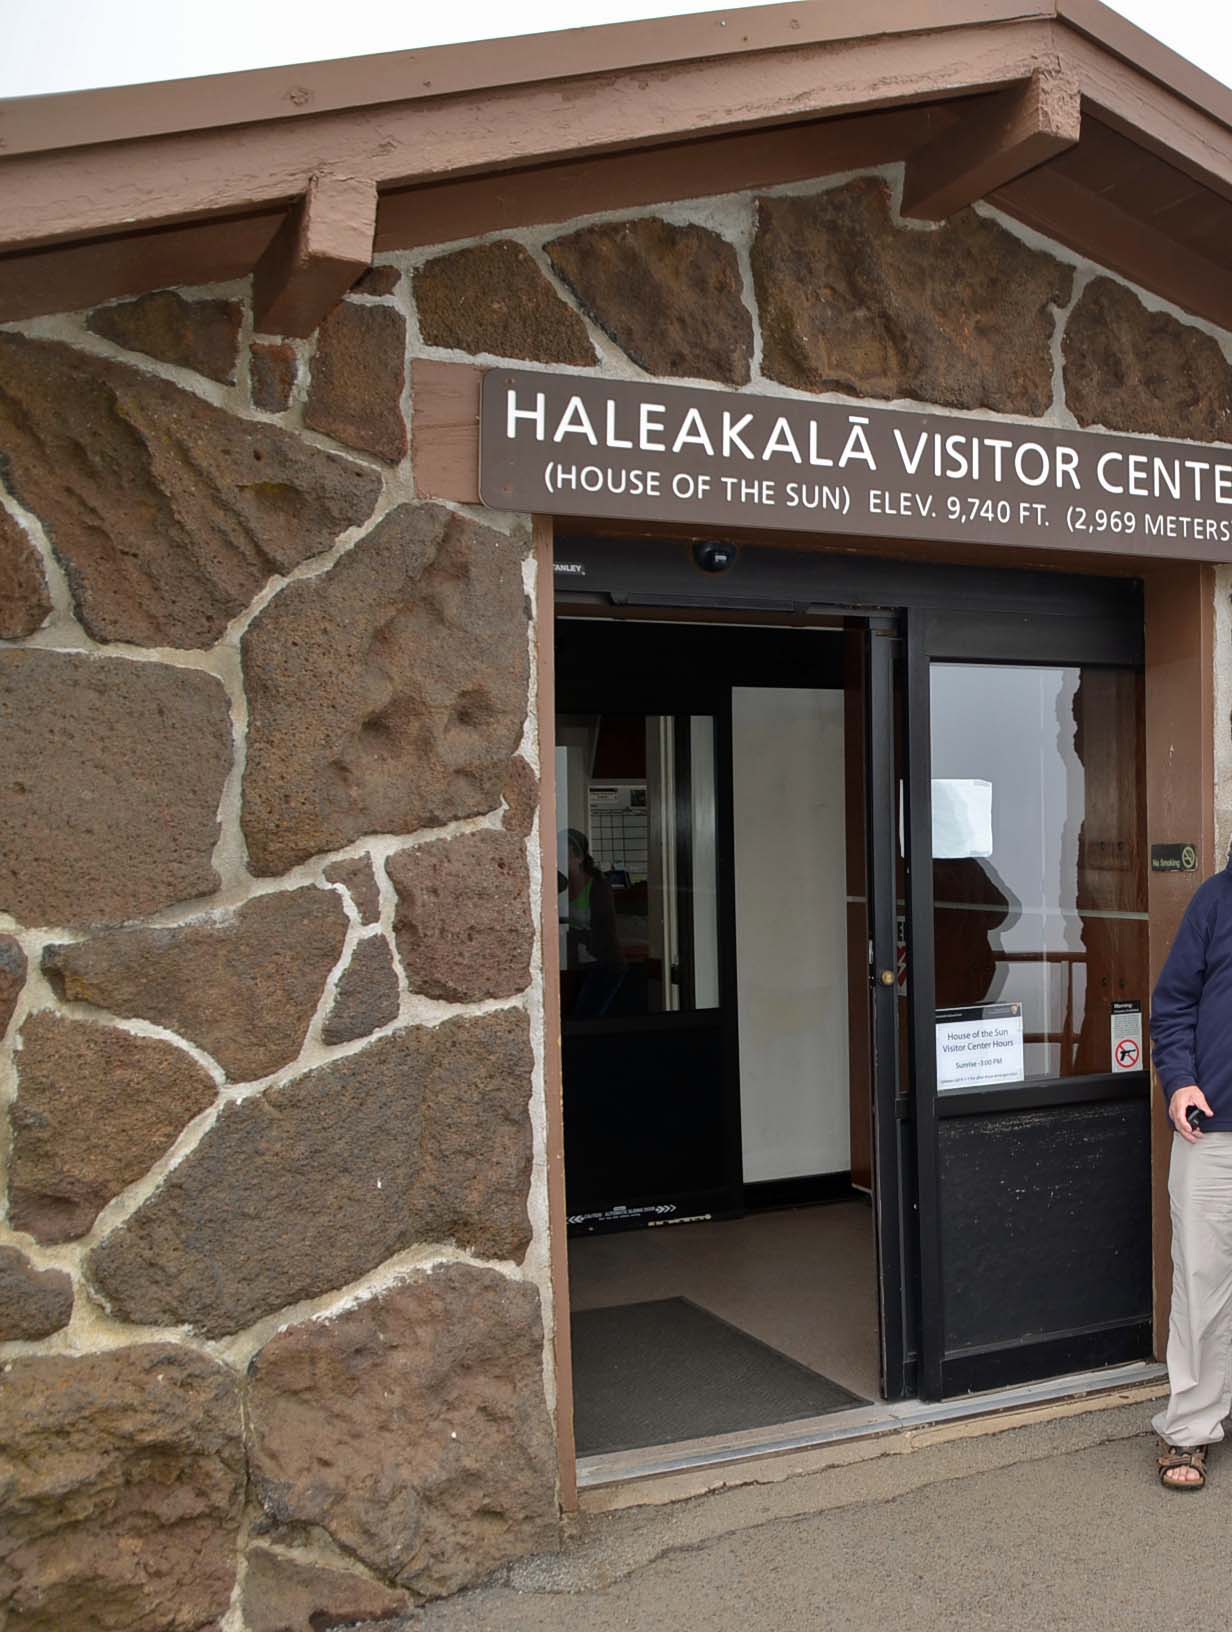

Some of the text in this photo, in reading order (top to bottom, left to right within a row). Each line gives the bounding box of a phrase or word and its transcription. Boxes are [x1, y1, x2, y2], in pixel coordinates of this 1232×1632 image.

[506, 390, 877, 470] HALEAKALĀ
[894, 429, 1080, 490] VISITOR
[544, 461, 661, 496] (HOUSE
[672, 473, 710, 500] OF
[720, 477, 775, 505] THE
[786, 482, 850, 515] SUN)
[869, 490, 937, 518] ELEV.
[947, 496, 1011, 524] 9,740
[1019, 503, 1050, 526] FT.
[1066, 506, 1136, 534] (2,969
[947, 1028, 1009, 1041] House of the Sun
[942, 1039, 1014, 1053] Visitor Center Hours
[955, 1061, 977, 1069] Sunrise
[992, 1057, 1003, 1065] PM
